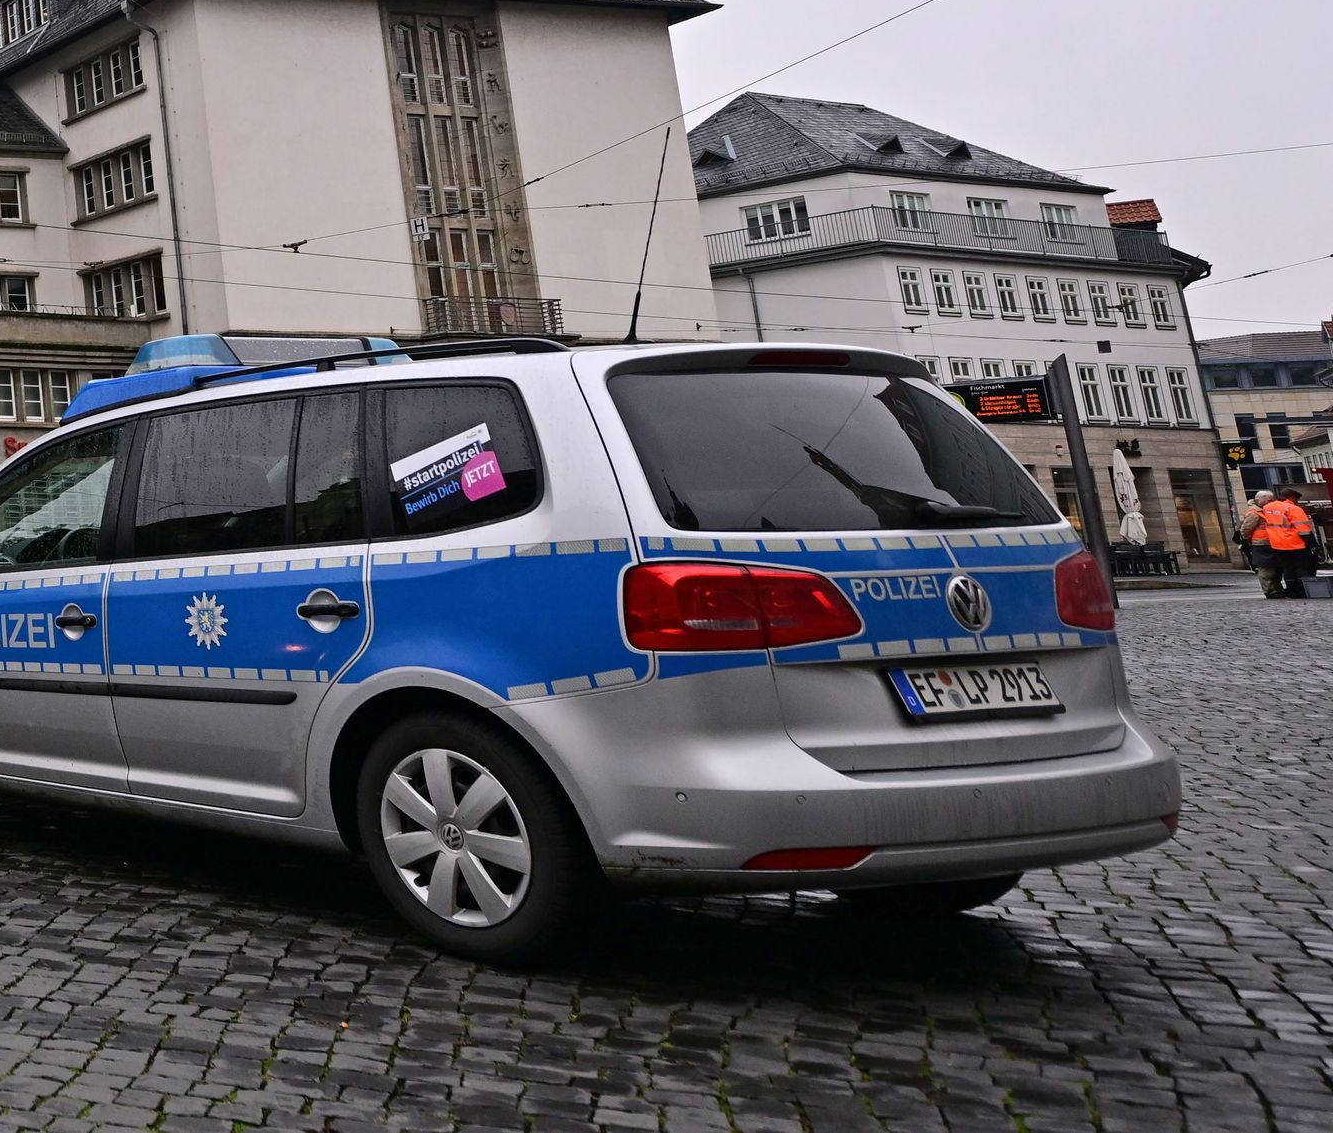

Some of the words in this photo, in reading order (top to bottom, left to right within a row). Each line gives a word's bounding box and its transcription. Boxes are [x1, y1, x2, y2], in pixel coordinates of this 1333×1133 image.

[414, 218, 425, 233] H
[403, 442, 480, 491] #startpolizei
[465, 460, 496, 487] JETZT
[405, 491, 438, 515] Bewirb
[438, 480, 461, 498] Dich
[850, 575, 942, 601] POLIZEI
[908, 672, 944, 707] EF
[953, 670, 990, 704] LP
[989, 667, 1052, 703] 2913
